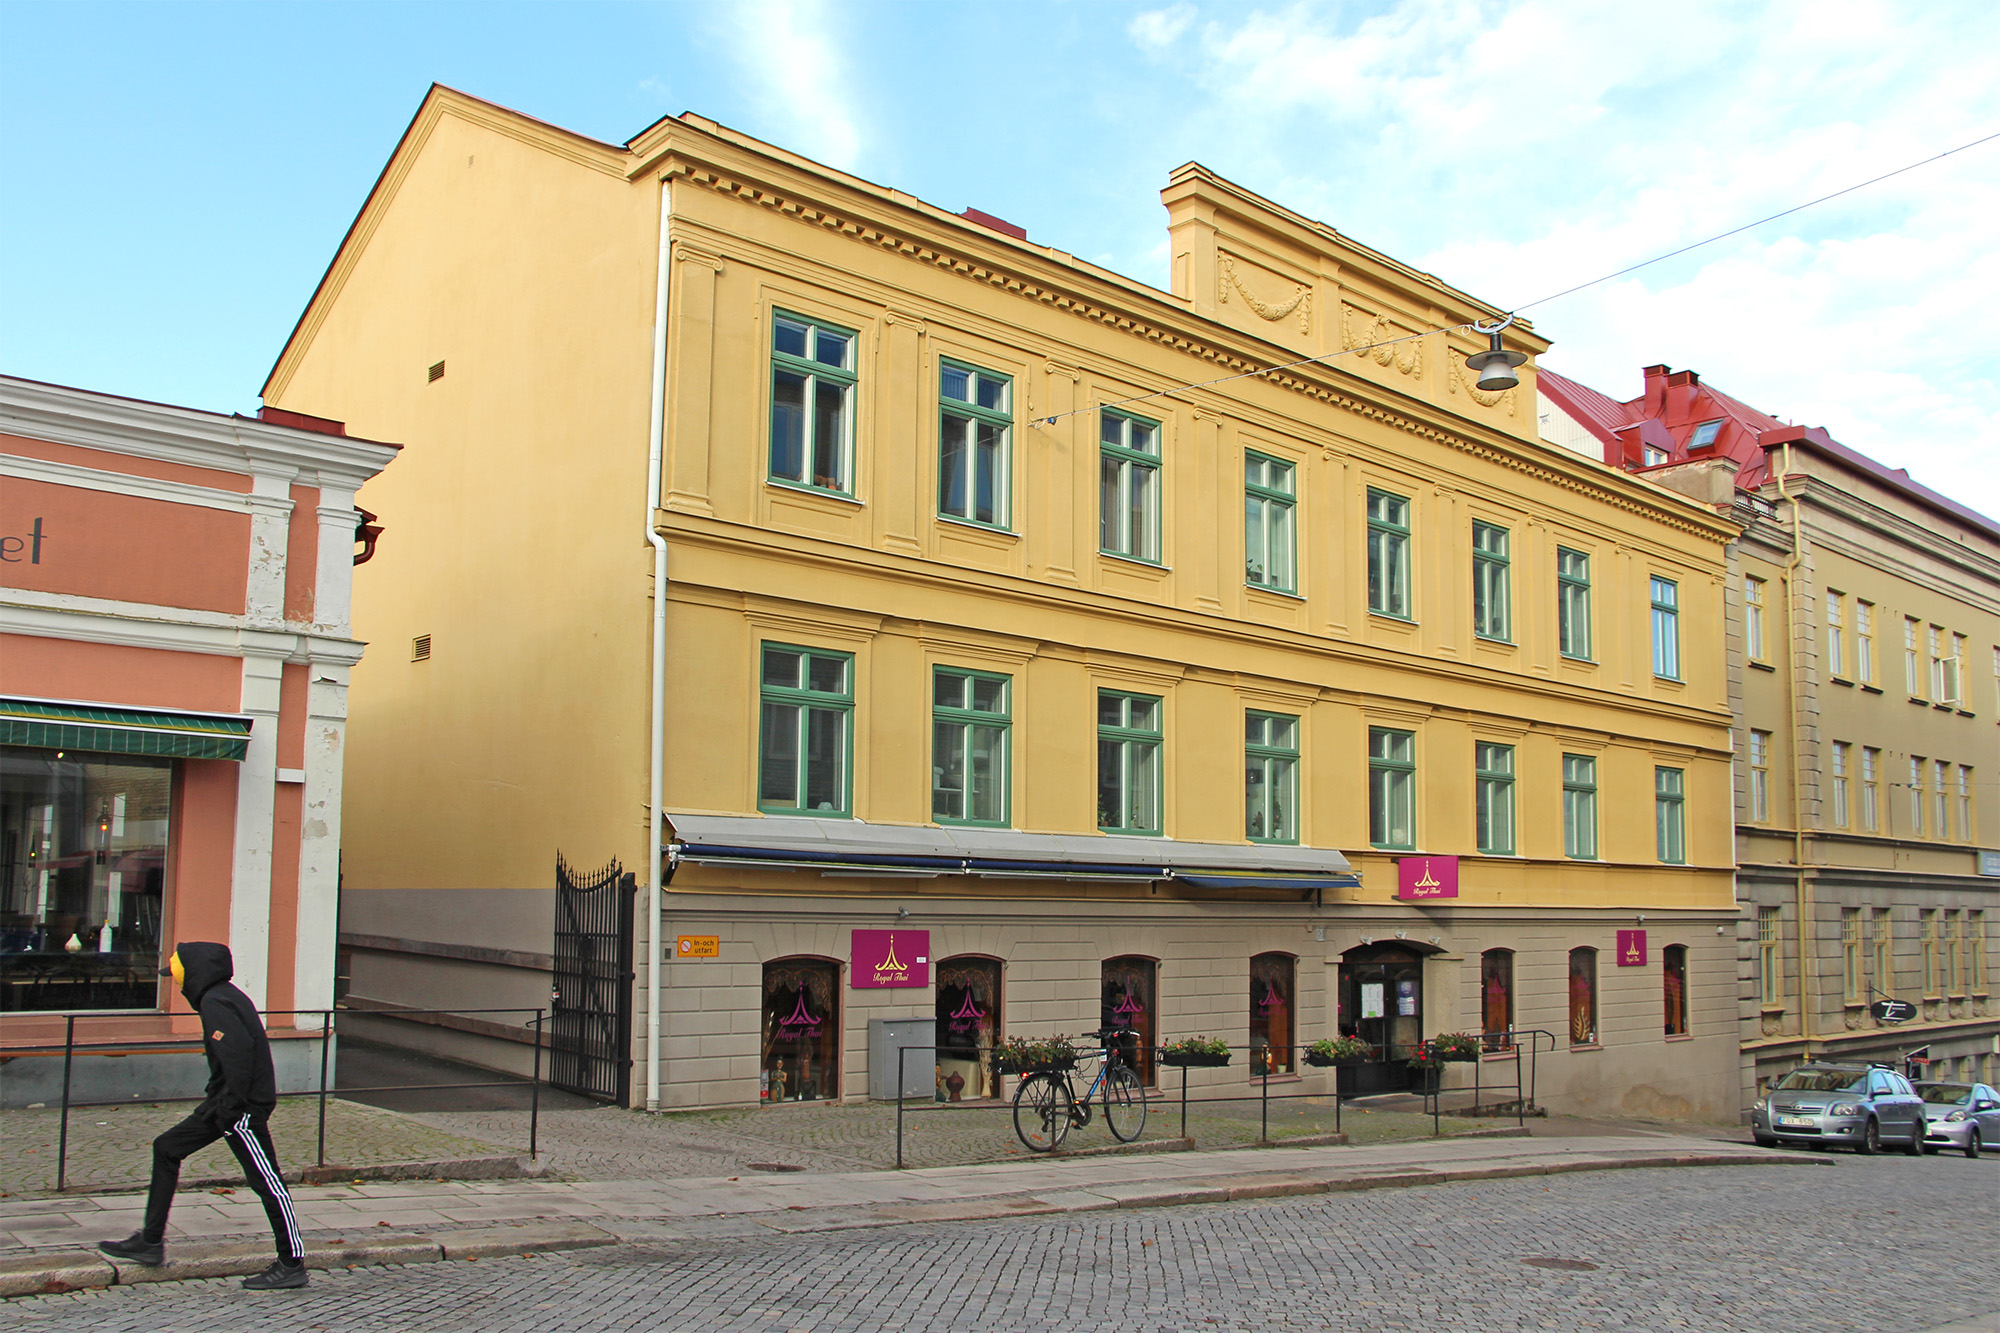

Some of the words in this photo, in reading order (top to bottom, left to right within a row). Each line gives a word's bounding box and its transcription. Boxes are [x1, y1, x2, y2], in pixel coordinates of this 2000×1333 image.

[872, 972, 894, 985] Royal
[893, 972, 910, 982] Thai
[776, 1027, 803, 1043] Royal
[803, 1026, 823, 1039] Thai
